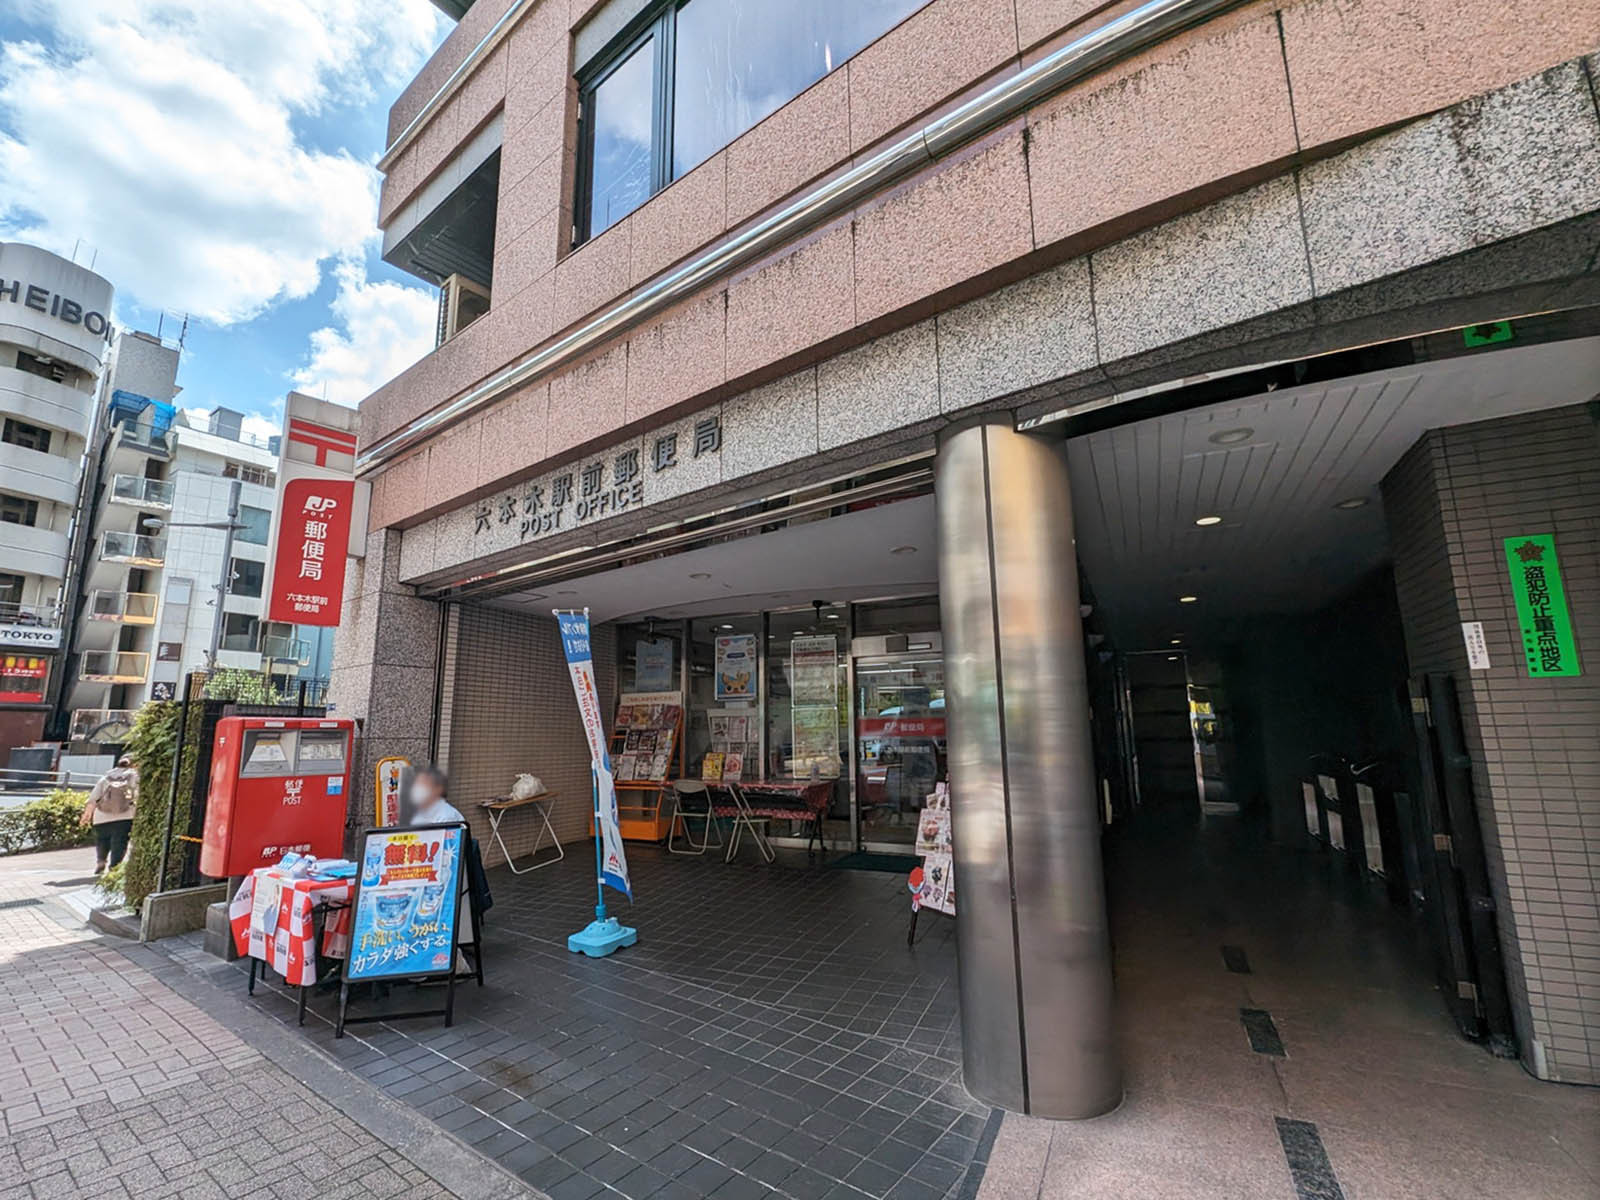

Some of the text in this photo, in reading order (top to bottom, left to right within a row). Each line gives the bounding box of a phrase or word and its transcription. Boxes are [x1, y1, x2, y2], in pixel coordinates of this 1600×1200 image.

[474, 416, 721, 535] 六本木駅前郵便局
[520, 481, 643, 539] POST OFFICE
[299, 520, 328, 580] 郵便局
[1, 630, 53, 641] TOKYO
[283, 796, 302, 805] POST
